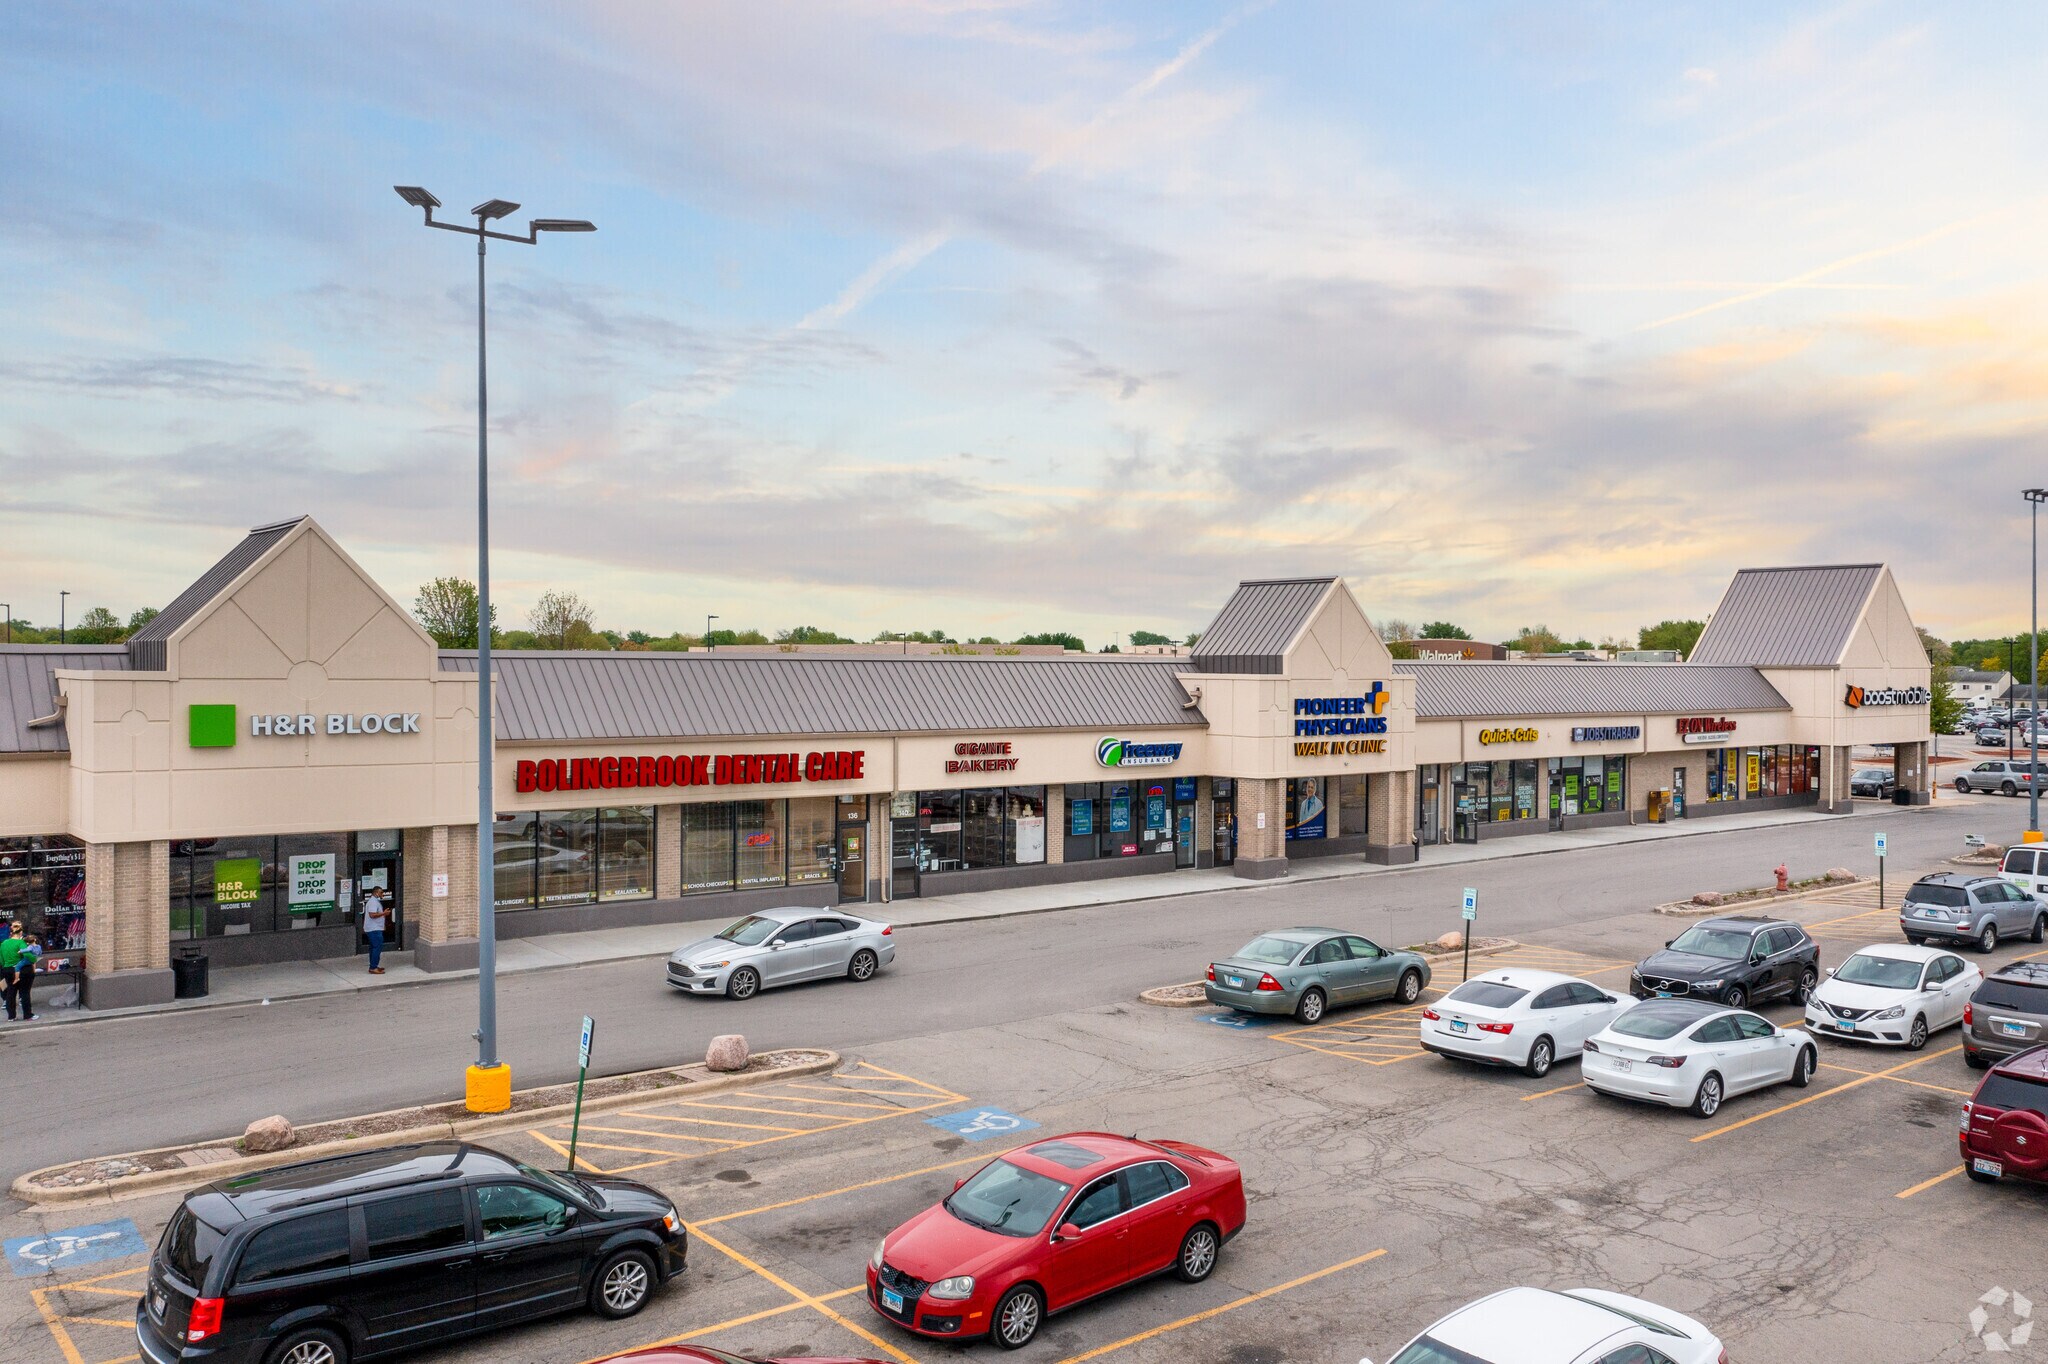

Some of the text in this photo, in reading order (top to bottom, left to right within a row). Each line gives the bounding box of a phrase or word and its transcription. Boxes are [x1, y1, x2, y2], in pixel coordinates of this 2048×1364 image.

[1418, 649, 1463, 661] Walmart
[1294, 697, 1366, 716] PIONEER
[251, 713, 422, 737] H&R BLOCK
[1294, 716, 1388, 737] PHYSICIANS
[1676, 718, 1690, 734] EZ
[1703, 717, 1737, 733] Wireless
[955, 742, 1012, 756] GIGANTE
[1120, 741, 1183, 760] Freeway
[1294, 740, 1388, 757] WALK IN CLINIC
[516, 750, 865, 793] BOLINGBROOK DENTAL CARE
[946, 759, 1019, 773] BAKERY
[847, 812, 858, 820] 136
[746, 834, 771, 847] OPEN
[298, 861, 326, 870] DROP
[217, 881, 243, 891] H&R
[298, 880, 326, 889] DROP
[217, 890, 258, 901] BLOCK
